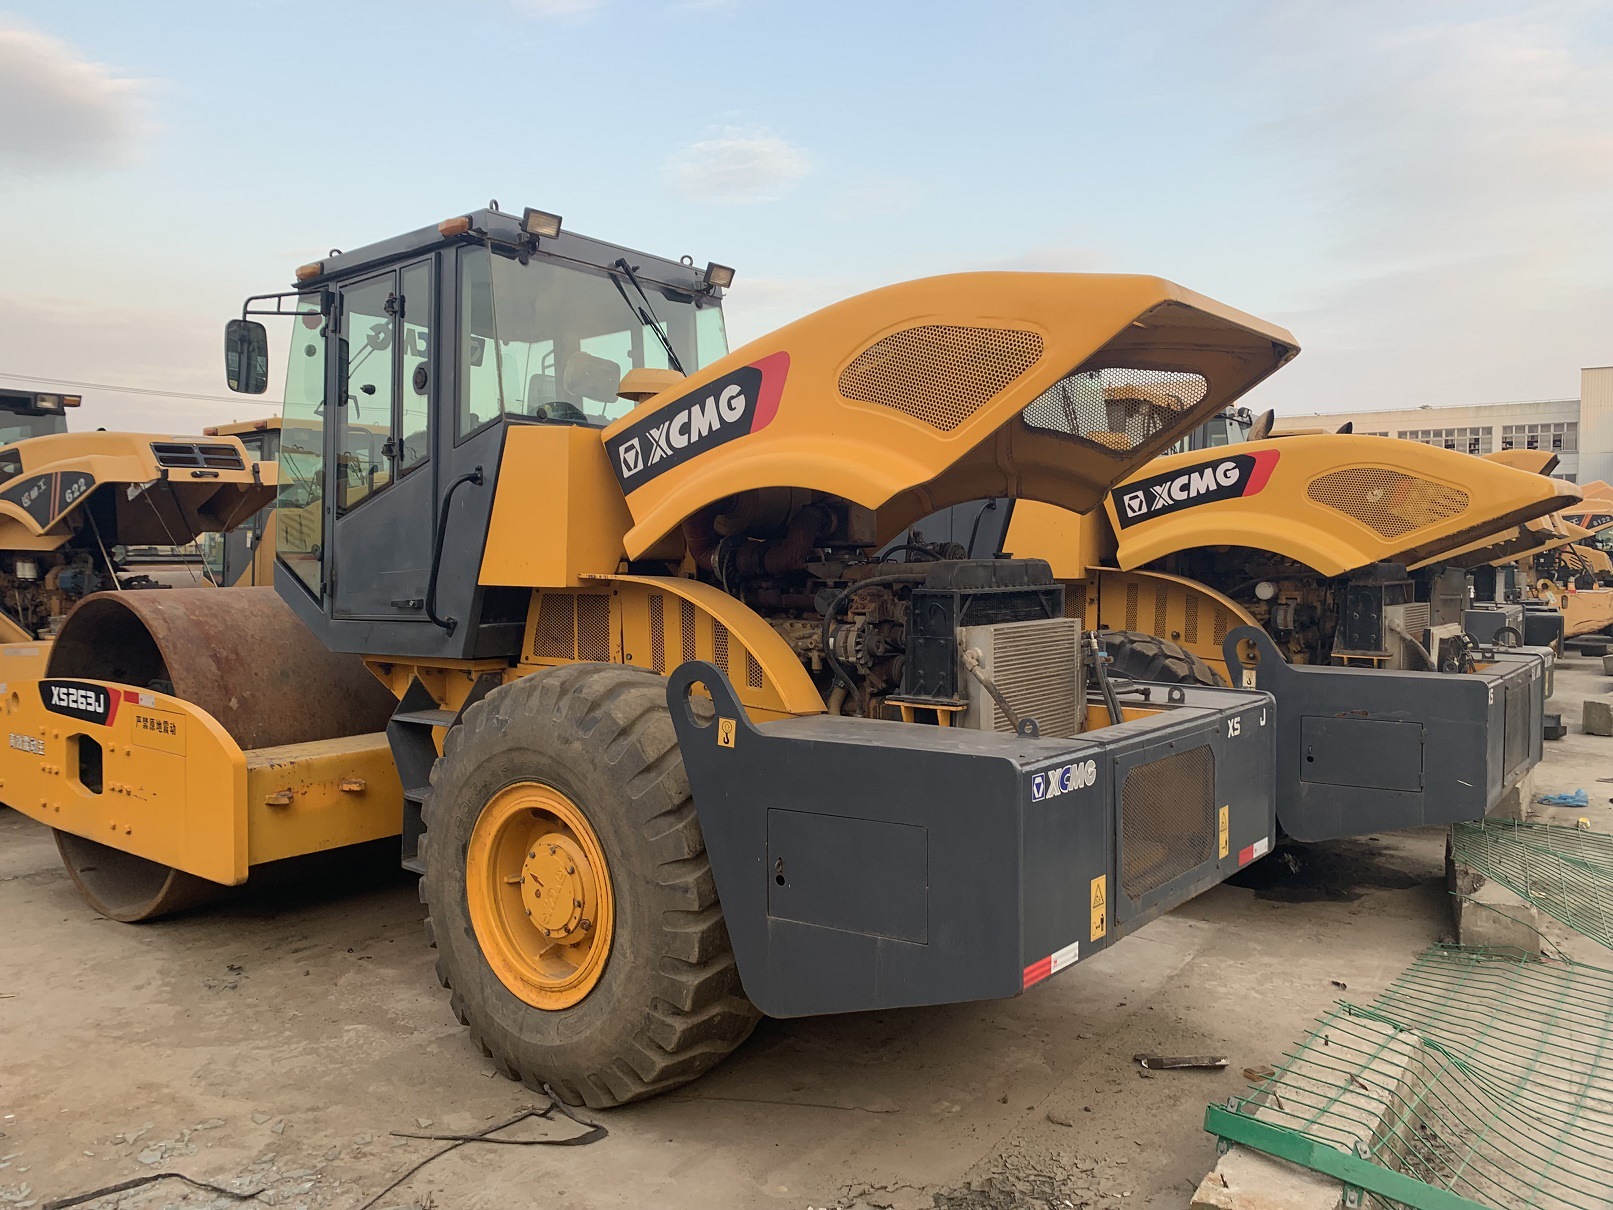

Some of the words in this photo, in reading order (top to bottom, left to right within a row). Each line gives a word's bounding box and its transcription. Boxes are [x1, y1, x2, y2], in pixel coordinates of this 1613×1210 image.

[647, 384, 746, 467] XCMG
[65, 478, 87, 503] 622
[1150, 461, 1240, 511] XCMG
[50, 686, 104, 714] XS263J
[1227, 716, 1241, 739] XS
[1259, 707, 1266, 727] J
[1046, 759, 1097, 799] XCMG
